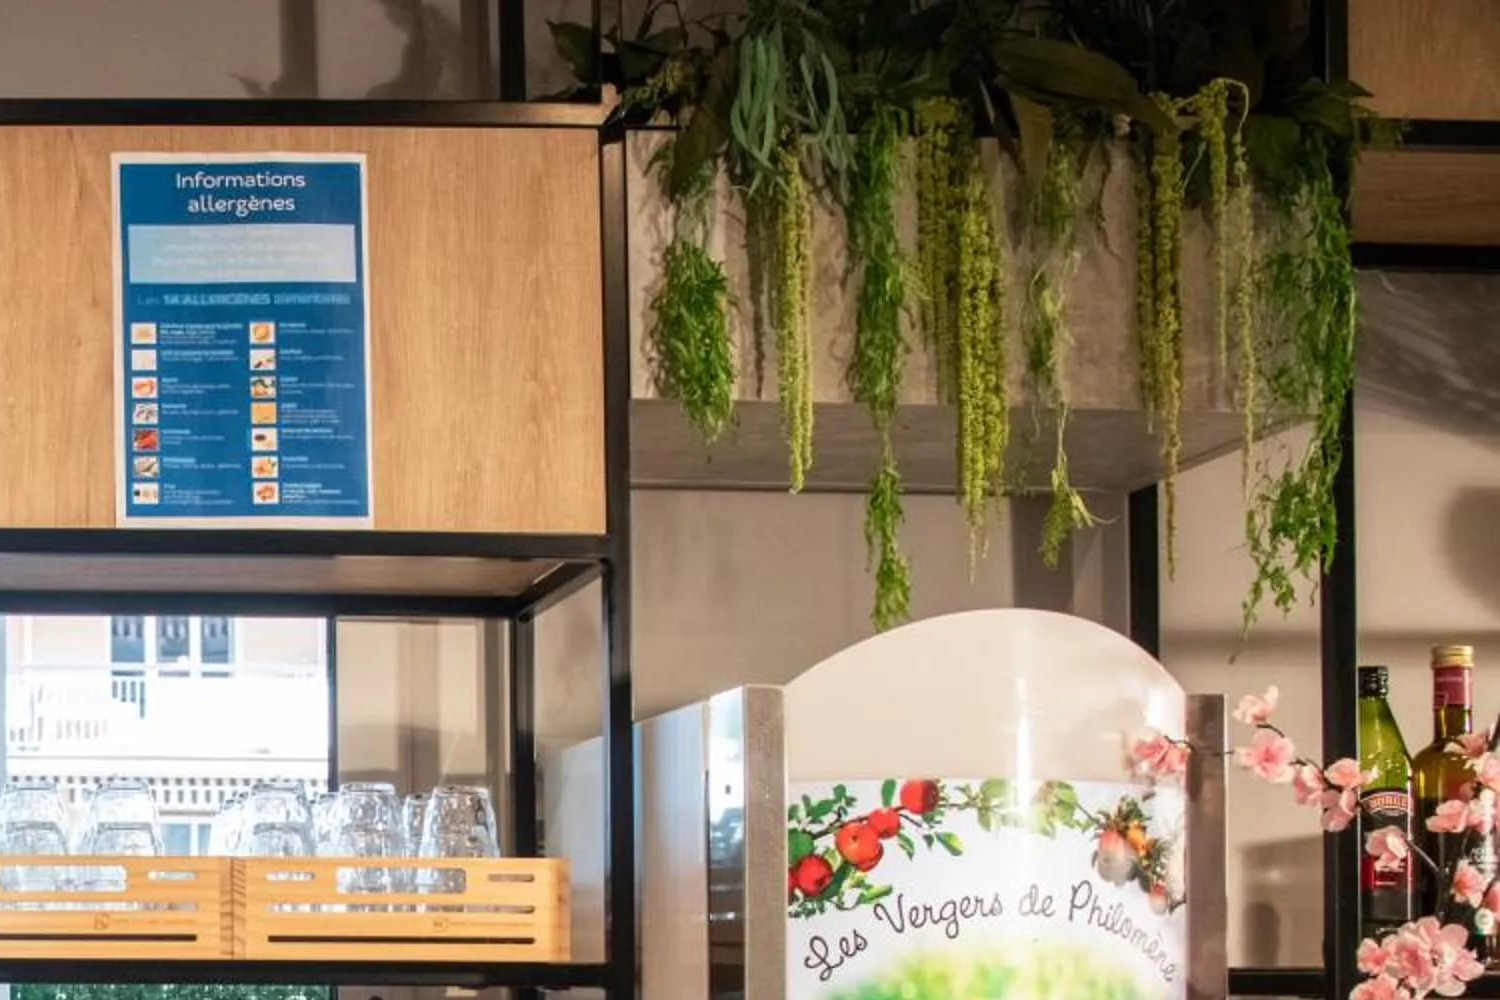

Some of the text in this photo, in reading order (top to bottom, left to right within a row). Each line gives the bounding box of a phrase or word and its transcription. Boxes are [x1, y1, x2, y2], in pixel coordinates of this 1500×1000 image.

[176, 171, 306, 190] Informations
[187, 195, 296, 217] allergènes
[803, 879, 1179, 983] Les Vergers de Philomène
